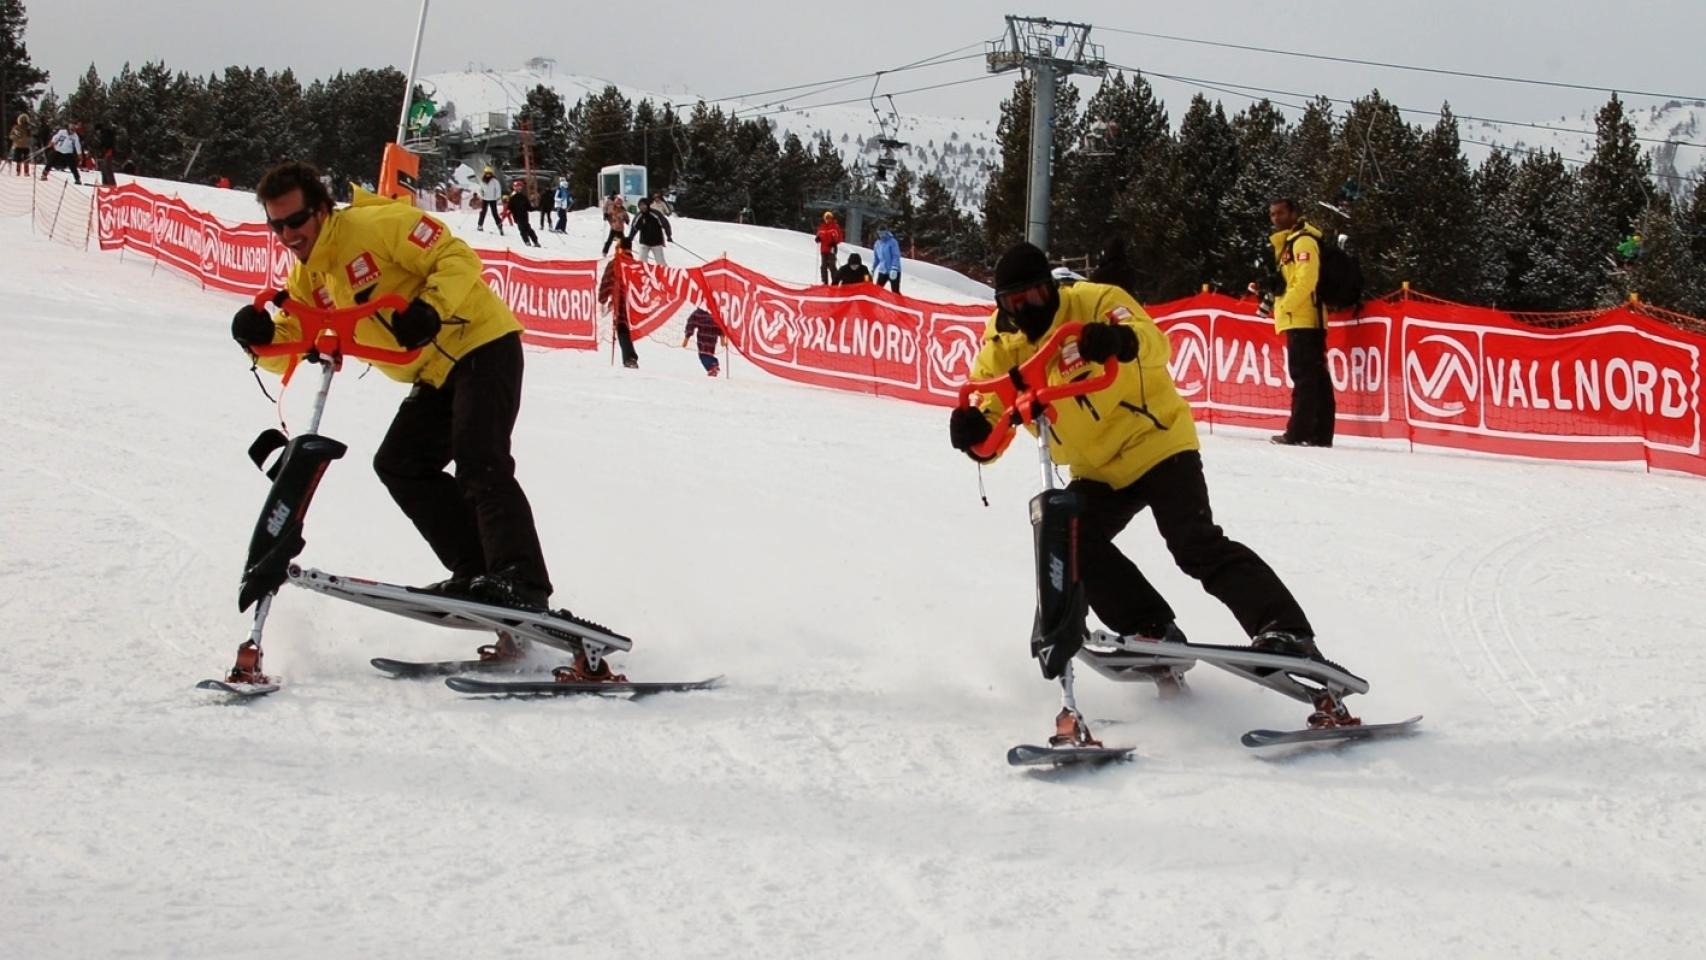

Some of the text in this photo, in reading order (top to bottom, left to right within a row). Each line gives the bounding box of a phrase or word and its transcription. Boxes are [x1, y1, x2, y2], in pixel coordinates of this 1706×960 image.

[219, 241, 267, 272] VALLNORD
[509, 281, 591, 321] VALLNORD
[800, 317, 916, 364] VALLNORD
[1215, 337, 1382, 392] VALLORD
[1487, 357, 1688, 418] VALLNORD
